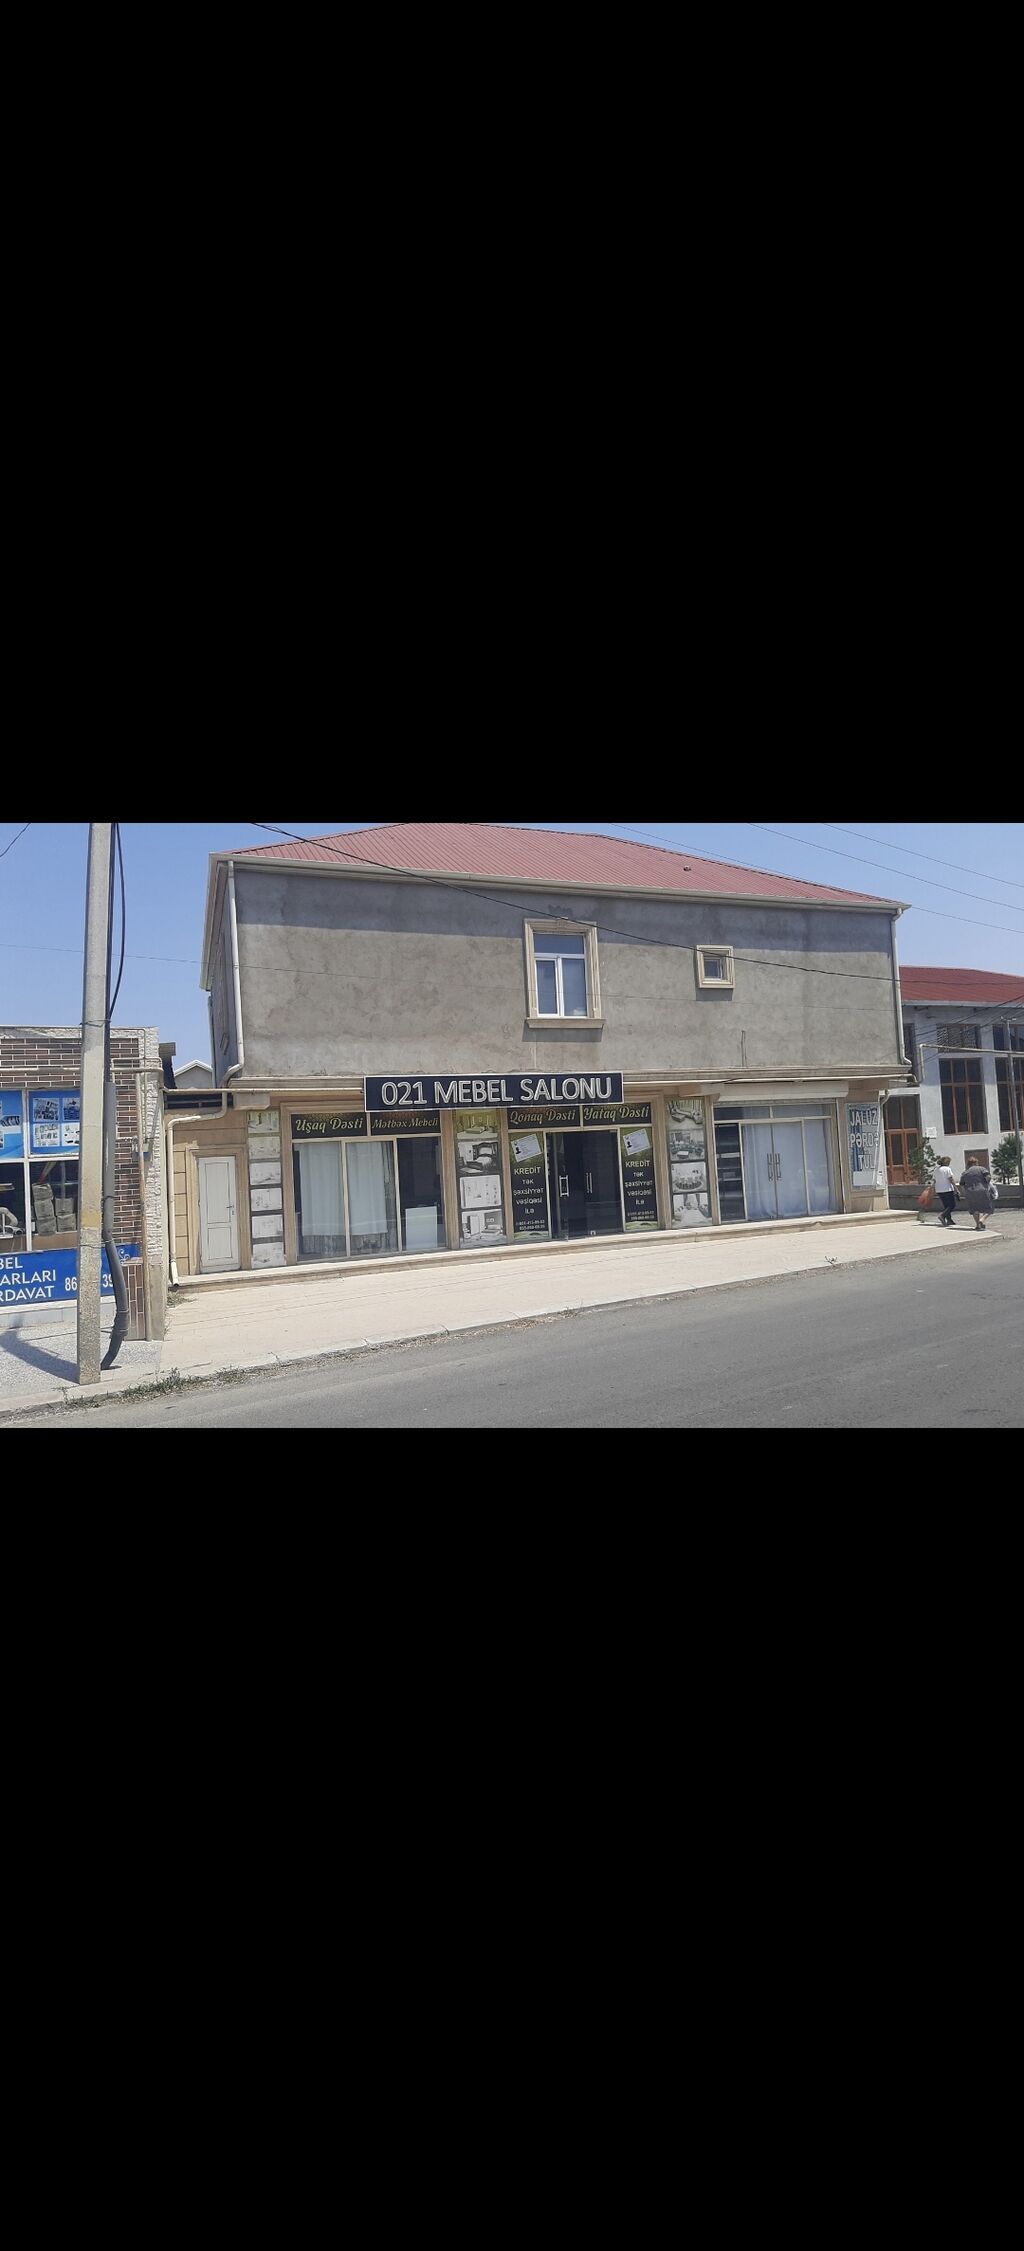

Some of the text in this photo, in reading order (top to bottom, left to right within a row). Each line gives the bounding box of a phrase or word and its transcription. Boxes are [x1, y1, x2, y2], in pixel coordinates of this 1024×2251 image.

[381, 1077, 612, 1106] 021 MEBEL SALONU
[510, 1108, 576, 1124] Qonaq Dəsti
[583, 1105, 649, 1122] Yataq Dəsti
[295, 1117, 364, 1133] Uşaq Dəsti
[513, 1166, 541, 1175] KREDİT
[625, 1160, 650, 1168] KREDİT
[64, 1276, 78, 1292] 86
